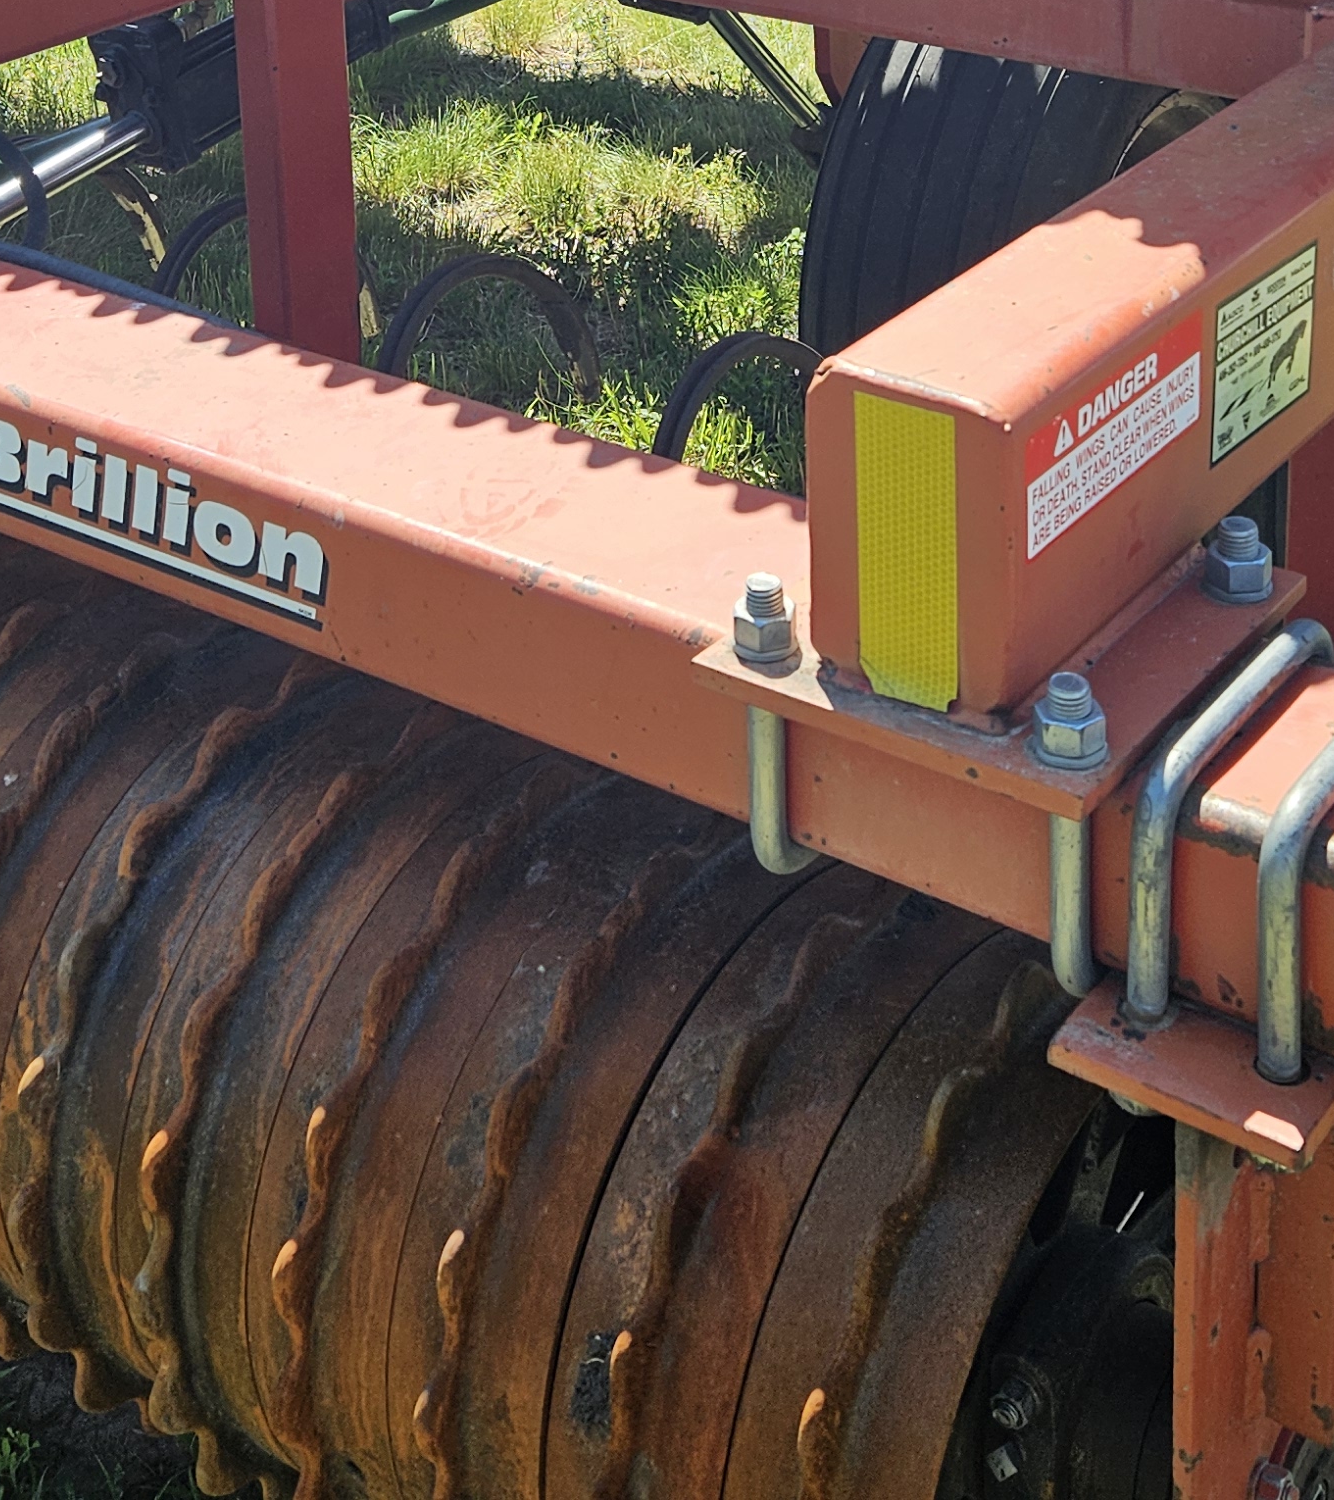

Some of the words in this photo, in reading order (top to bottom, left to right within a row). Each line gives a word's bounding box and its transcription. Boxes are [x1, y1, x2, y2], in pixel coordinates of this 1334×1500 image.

[1032, 462, 1070, 506] FALLING
[1075, 433, 1105, 469] WINGS
[1110, 414, 1129, 441] CAN
[1133, 388, 1162, 423] CAUSE
[1166, 361, 1196, 397] INJURY
[1032, 504, 1045, 527] OR
[1081, 450, 1111, 487] STAND
[1112, 427, 1141, 461] CLEAR
[1142, 404, 1167, 436] WHEN
[1168, 383, 1195, 416] WINGS
[1077, 352, 1158, 438] DANGER
[1032, 521, 1051, 551] ARE
[1053, 500, 1082, 531] BEING
[1083, 466, 1117, 506] RAISED
[1119, 454, 1132, 476] OR
[1134, 418, 1178, 464] LOWERED.
